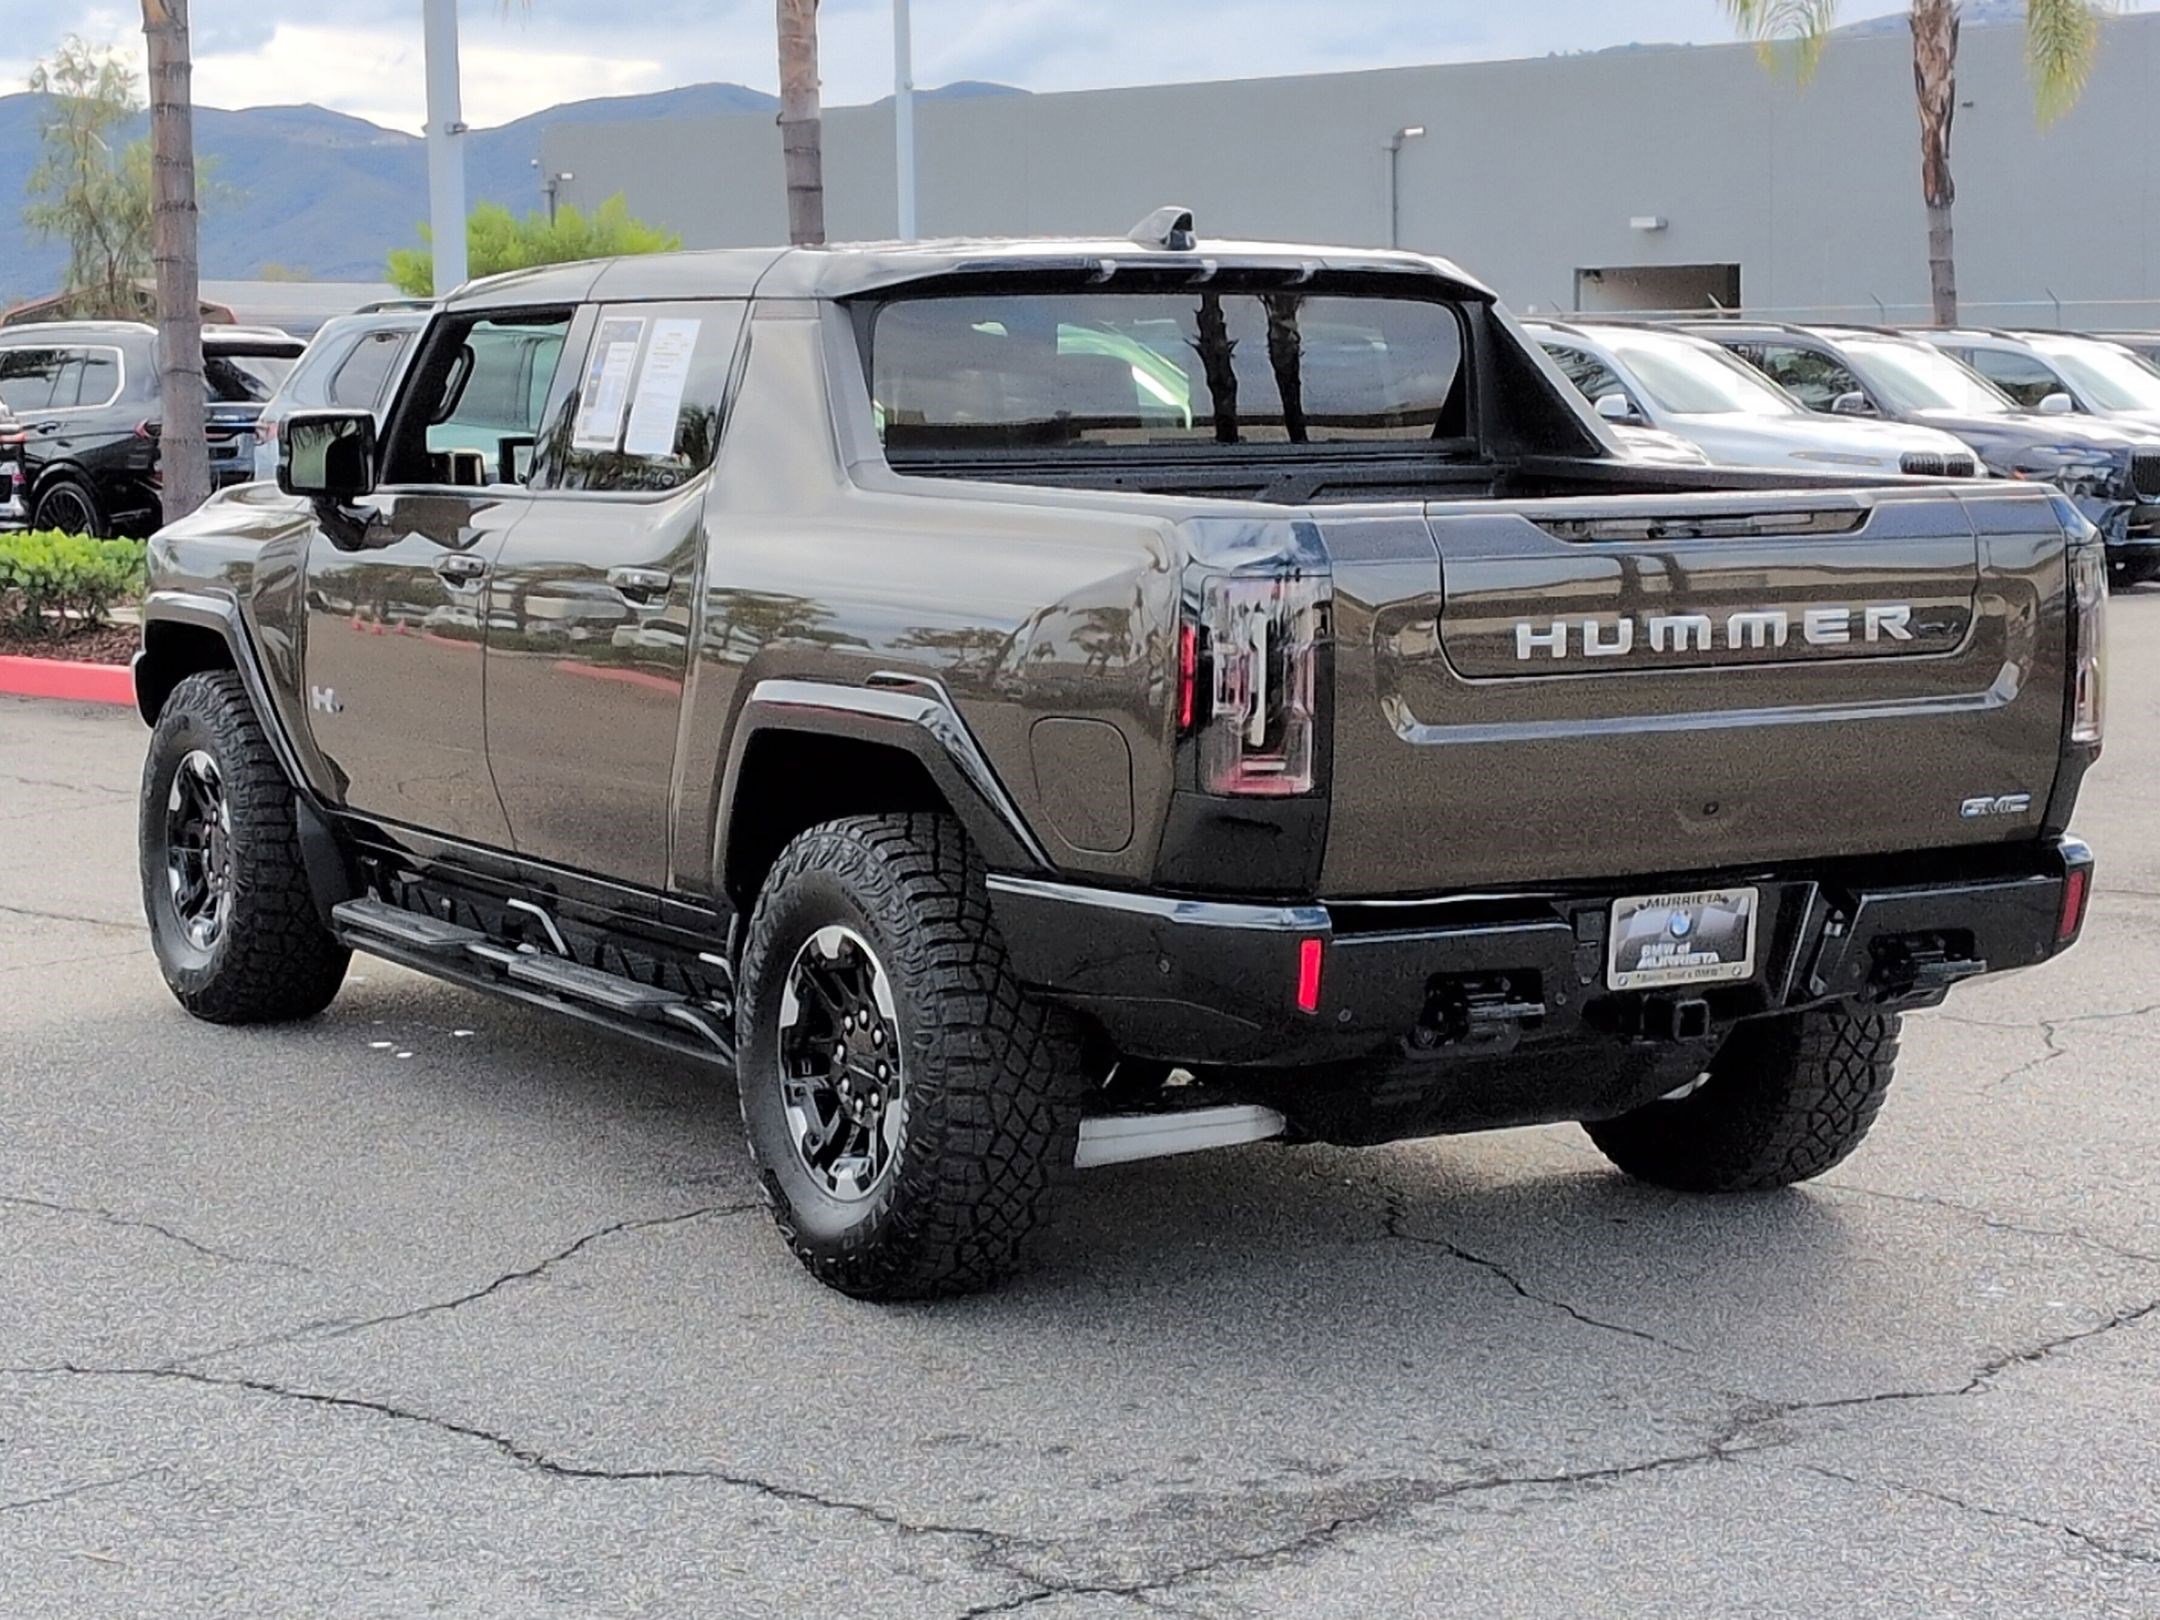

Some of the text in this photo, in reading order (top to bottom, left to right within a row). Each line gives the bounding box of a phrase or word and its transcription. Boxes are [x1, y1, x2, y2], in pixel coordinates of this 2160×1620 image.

[1516, 606, 1913, 659] HUMMER
[1961, 794, 2030, 817] GMC
[1646, 893, 1722, 908] MURRIETA
[1641, 943, 1676, 956] BMW
[1636, 952, 1719, 969] MURRIETA
